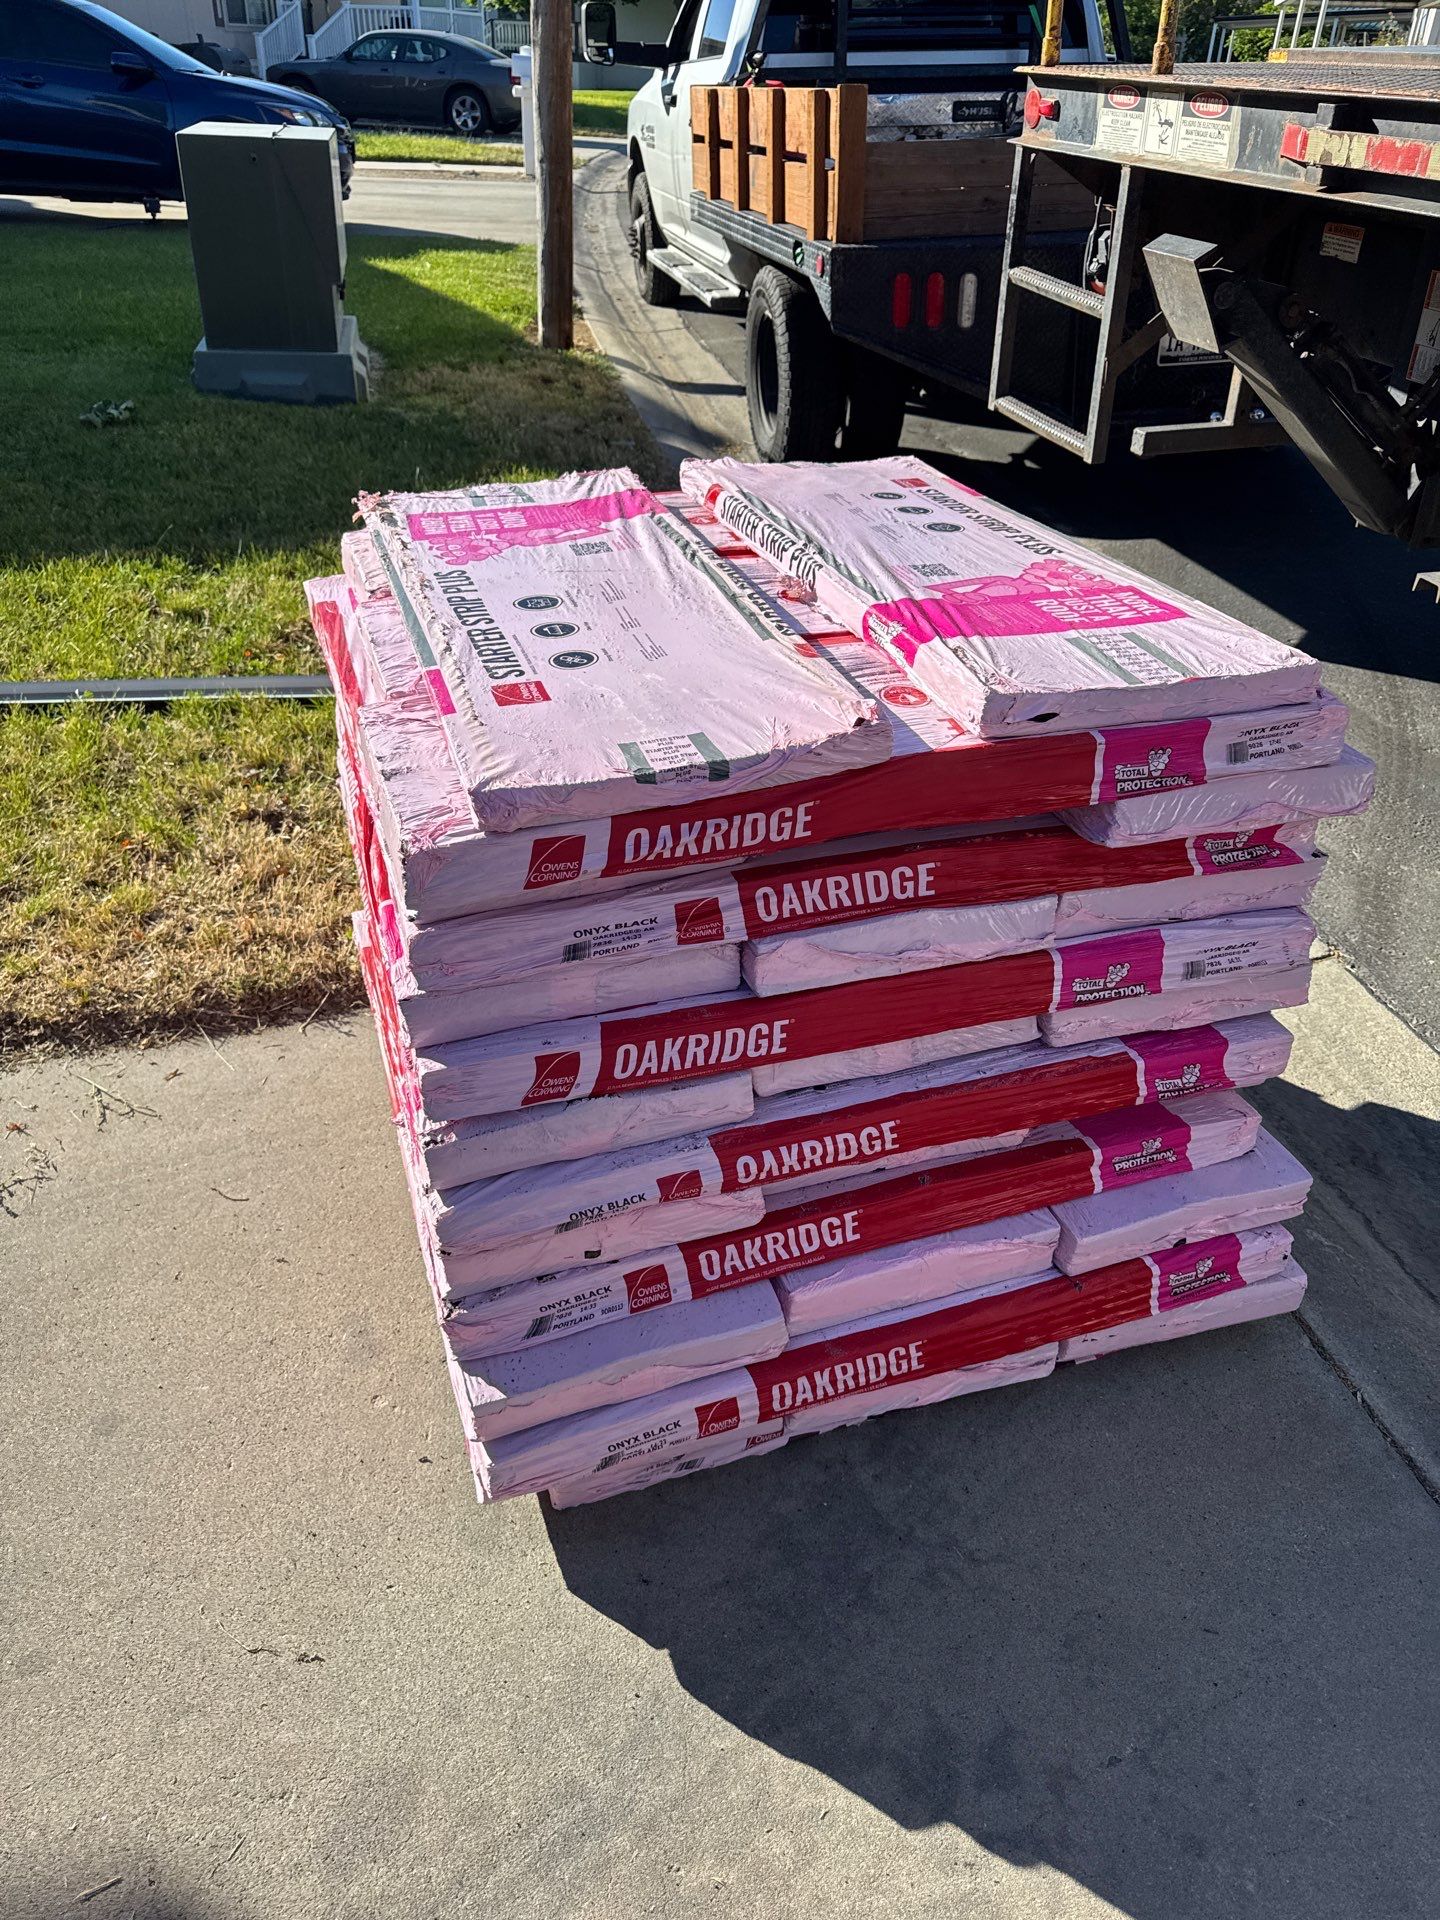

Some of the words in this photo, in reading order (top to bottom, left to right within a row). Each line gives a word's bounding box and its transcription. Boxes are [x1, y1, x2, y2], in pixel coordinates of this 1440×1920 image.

[1195, 97, 1223, 113] PELIGRO
[917, 489, 980, 514] STARTER
[966, 514, 1022, 539] STRIP
[1014, 534, 1064, 555] PLUS
[720, 495, 763, 543] STARTER
[760, 523, 796, 562] STRIP
[789, 547, 824, 592] PLUS
[434, 569, 478, 595] PLUS
[446, 596, 495, 627] STRIP
[1030, 599, 1090, 623] ROOF
[1064, 597, 1095, 617] JUST
[1089, 593, 1143, 620] THAN
[1114, 591, 1168, 616] MORE
[467, 626, 526, 680] STARTER
[650, 754, 679, 762] STARTER
[1249, 747, 1285, 760] PORTLAND
[1121, 768, 1146, 778] TOTAL
[1117, 776, 1187, 793] PROTECTION
[624, 800, 815, 864] OAKRIDGE
[1210, 841, 1231, 850] TOTAL
[1212, 845, 1269, 866] PROTECTION
[530, 870, 579, 883] CORNING
[541, 861, 579, 873] OWENS
[754, 862, 937, 923] OAKRIDGE
[573, 923, 612, 939] ONYX
[614, 917, 658, 930] BLACK
[681, 927, 721, 939] CORNING
[592, 942, 640, 957] PORTLAND
[1206, 966, 1243, 976] PORTLAND
[1075, 985, 1145, 1002] PROTECTION
[1078, 980, 1101, 989] TOTAL
[613, 1019, 790, 1080] OAKRIDGE
[529, 1084, 571, 1098] CORNING
[542, 1075, 575, 1087] OWENS
[1160, 1081, 1182, 1090] TOTAL
[736, 1120, 900, 1184] OAKRIDGE
[1114, 1149, 1174, 1172] PROTECTION
[569, 1205, 606, 1222] ONYX
[608, 1192, 647, 1211] BLACK
[698, 1210, 861, 1282] OAKRIDGE
[539, 1298, 571, 1313] ONYX
[574, 1285, 613, 1302] BLACK
[631, 1290, 670, 1309] CORNING
[638, 1282, 668, 1297] OWENS
[552, 1313, 595, 1331] PORTLAND
[771, 1340, 926, 1412] OAKRIDGE
[708, 1416, 738, 1431] OWENS
[607, 1435, 641, 1453] ONYX
[643, 1420, 682, 1440] BLACK
